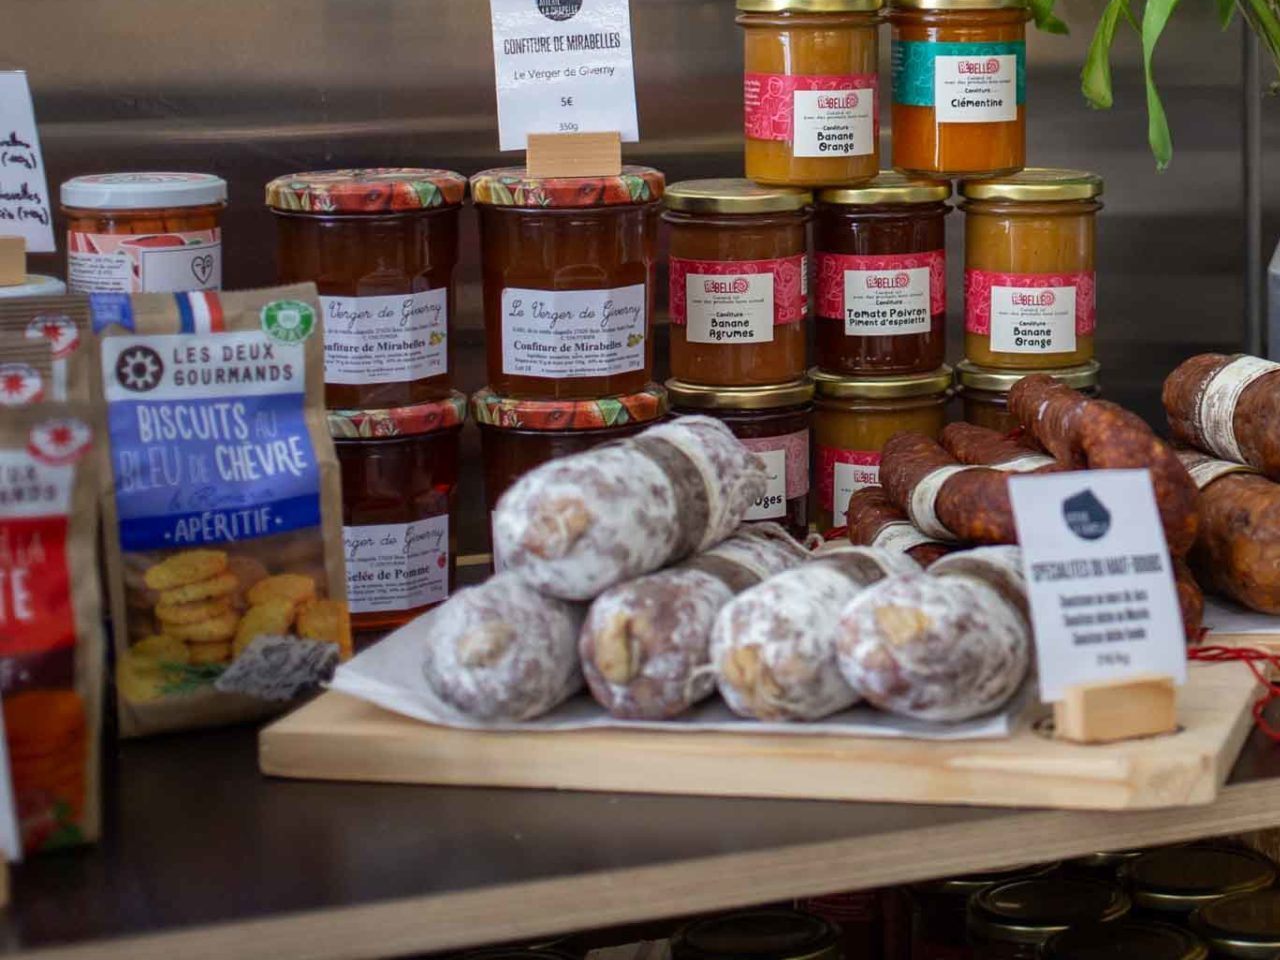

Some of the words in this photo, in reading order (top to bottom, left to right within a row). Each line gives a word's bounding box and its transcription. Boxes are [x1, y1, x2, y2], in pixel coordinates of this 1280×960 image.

[504, 38, 551, 55] CONFITURE
[554, 36, 566, 51] DE
[566, 32, 621, 51] MIRABELLES
[514, 70, 526, 81] Le
[528, 68, 561, 80] Verger
[564, 67, 577, 77] de
[579, 65, 615, 77] Giverny
[560, 96, 574, 106] 5€
[951, 97, 1003, 108] Clémentine
[817, 132, 854, 141] Banane
[818, 141, 854, 153] Orange
[329, 301, 371, 329] Verger
[378, 306, 394, 319] de
[400, 299, 441, 327] Giverny
[509, 299, 524, 317] Le
[532, 301, 574, 328] Verger
[579, 306, 595, 319] de
[601, 300, 641, 327] Giverny
[847, 308, 887, 319] Tomate
[890, 307, 927, 318] Poivron
[711, 318, 749, 328] Banane
[849, 318, 878, 327] Piment
[709, 328, 754, 341] Agrumes
[1013, 327, 1052, 336] Banane
[324, 342, 359, 353] nfiture
[362, 343, 375, 352] de
[377, 339, 426, 352] Mirabelles
[513, 340, 557, 353] Confiture
[560, 342, 571, 353] de
[574, 339, 622, 352] Mirabelles
[1015, 337, 1052, 349] Orange
[173, 346, 210, 365] LES
[222, 344, 275, 363] DEUX
[173, 364, 293, 387] GOURMANDS
[136, 403, 249, 444] BISCUITS
[255, 410, 278, 437] AU
[119, 445, 183, 493] BLEU
[214, 435, 309, 482] CHÈVRE
[753, 495, 783, 509] uges
[175, 506, 272, 542] APÉRITIF
[380, 534, 397, 545] de
[378, 571, 391, 580] de
[395, 566, 430, 579] Pomme
